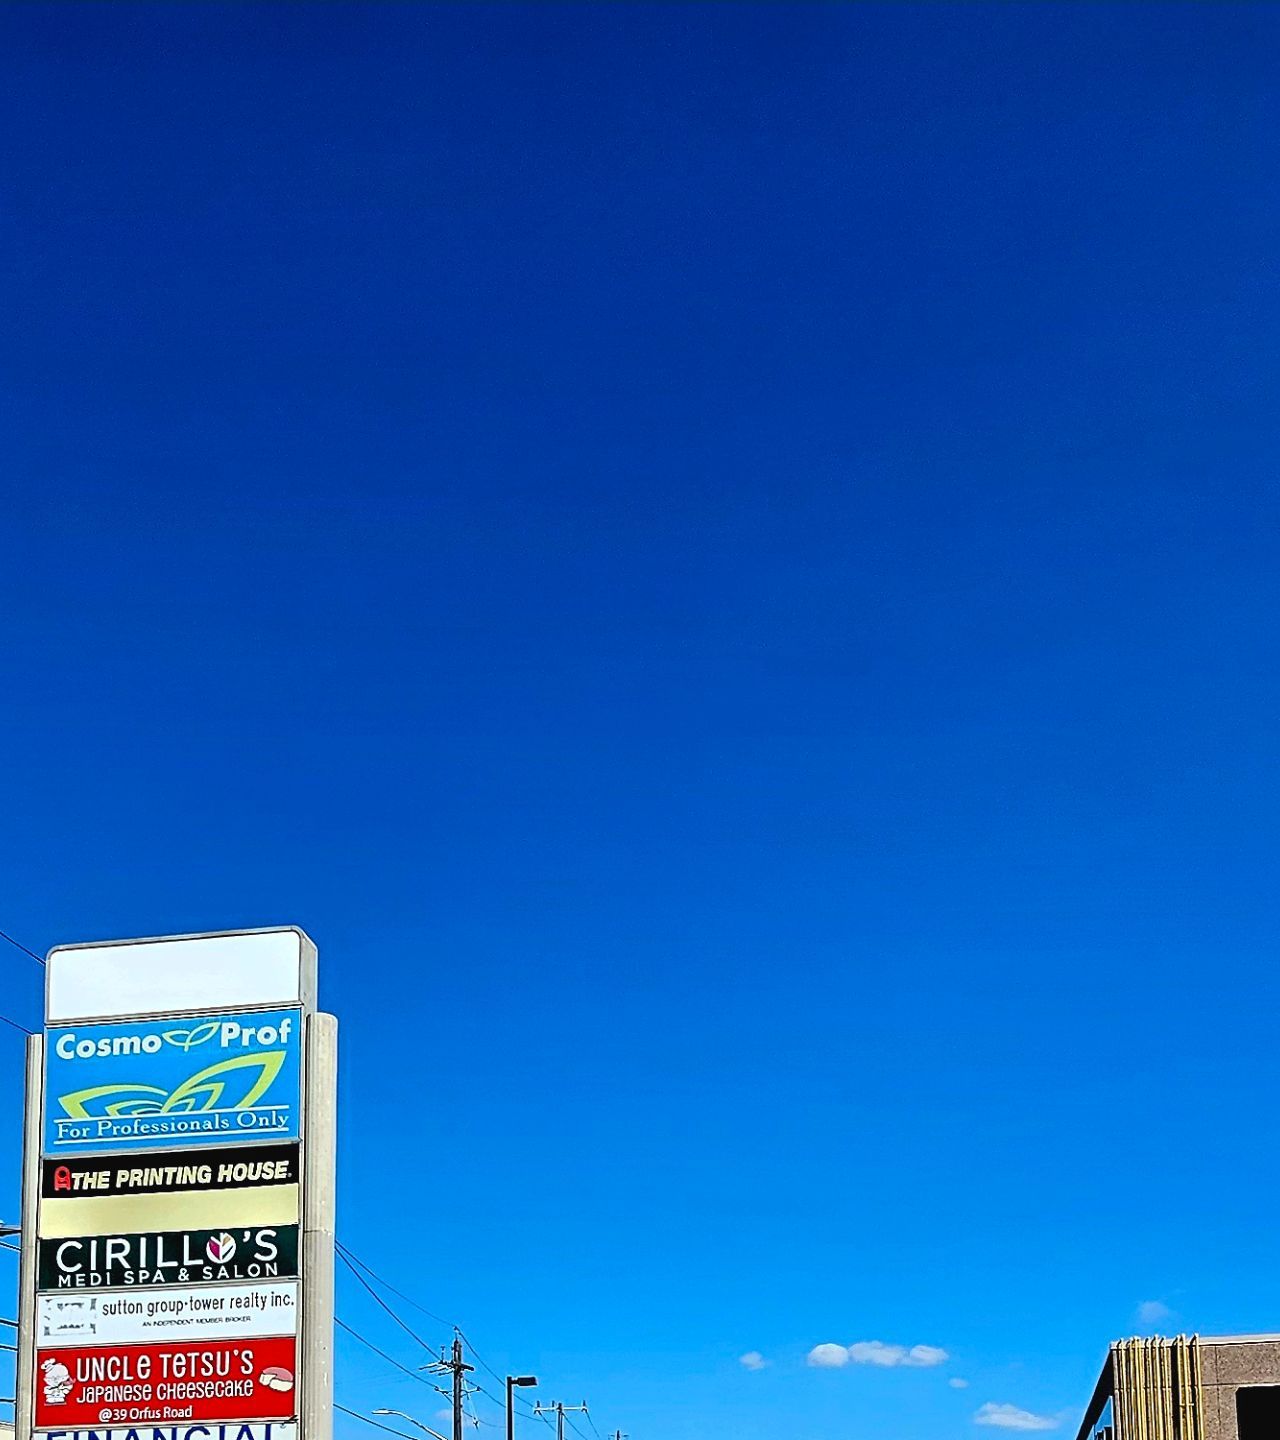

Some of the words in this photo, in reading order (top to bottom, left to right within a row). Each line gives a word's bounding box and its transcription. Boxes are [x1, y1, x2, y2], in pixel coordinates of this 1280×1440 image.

[55, 1032, 163, 1060] Cosmo
[220, 1018, 291, 1048] Prof
[57, 1122, 90, 1140] For
[97, 1115, 230, 1136] Professionals
[236, 1109, 289, 1130] Only
[71, 1171, 111, 1190] THE
[115, 1164, 212, 1189] PRINTING
[55, 1229, 278, 1273] CIRILLO'S
[58, 1272, 111, 1288] MEDI
[124, 1268, 165, 1284] SPA
[177, 1267, 190, 1282] &
[202, 1262, 278, 1280] SALON
[102, 1299, 143, 1316] sutton
[229, 1292, 267, 1312] realty
[271, 1291, 295, 1307] inc.
[153, 1318, 194, 1326] INDEPENDENT
[98, 1408, 127, 1422] @39
[129, 1406, 161, 1420] Orfus
[164, 1405, 193, 1418] Road
